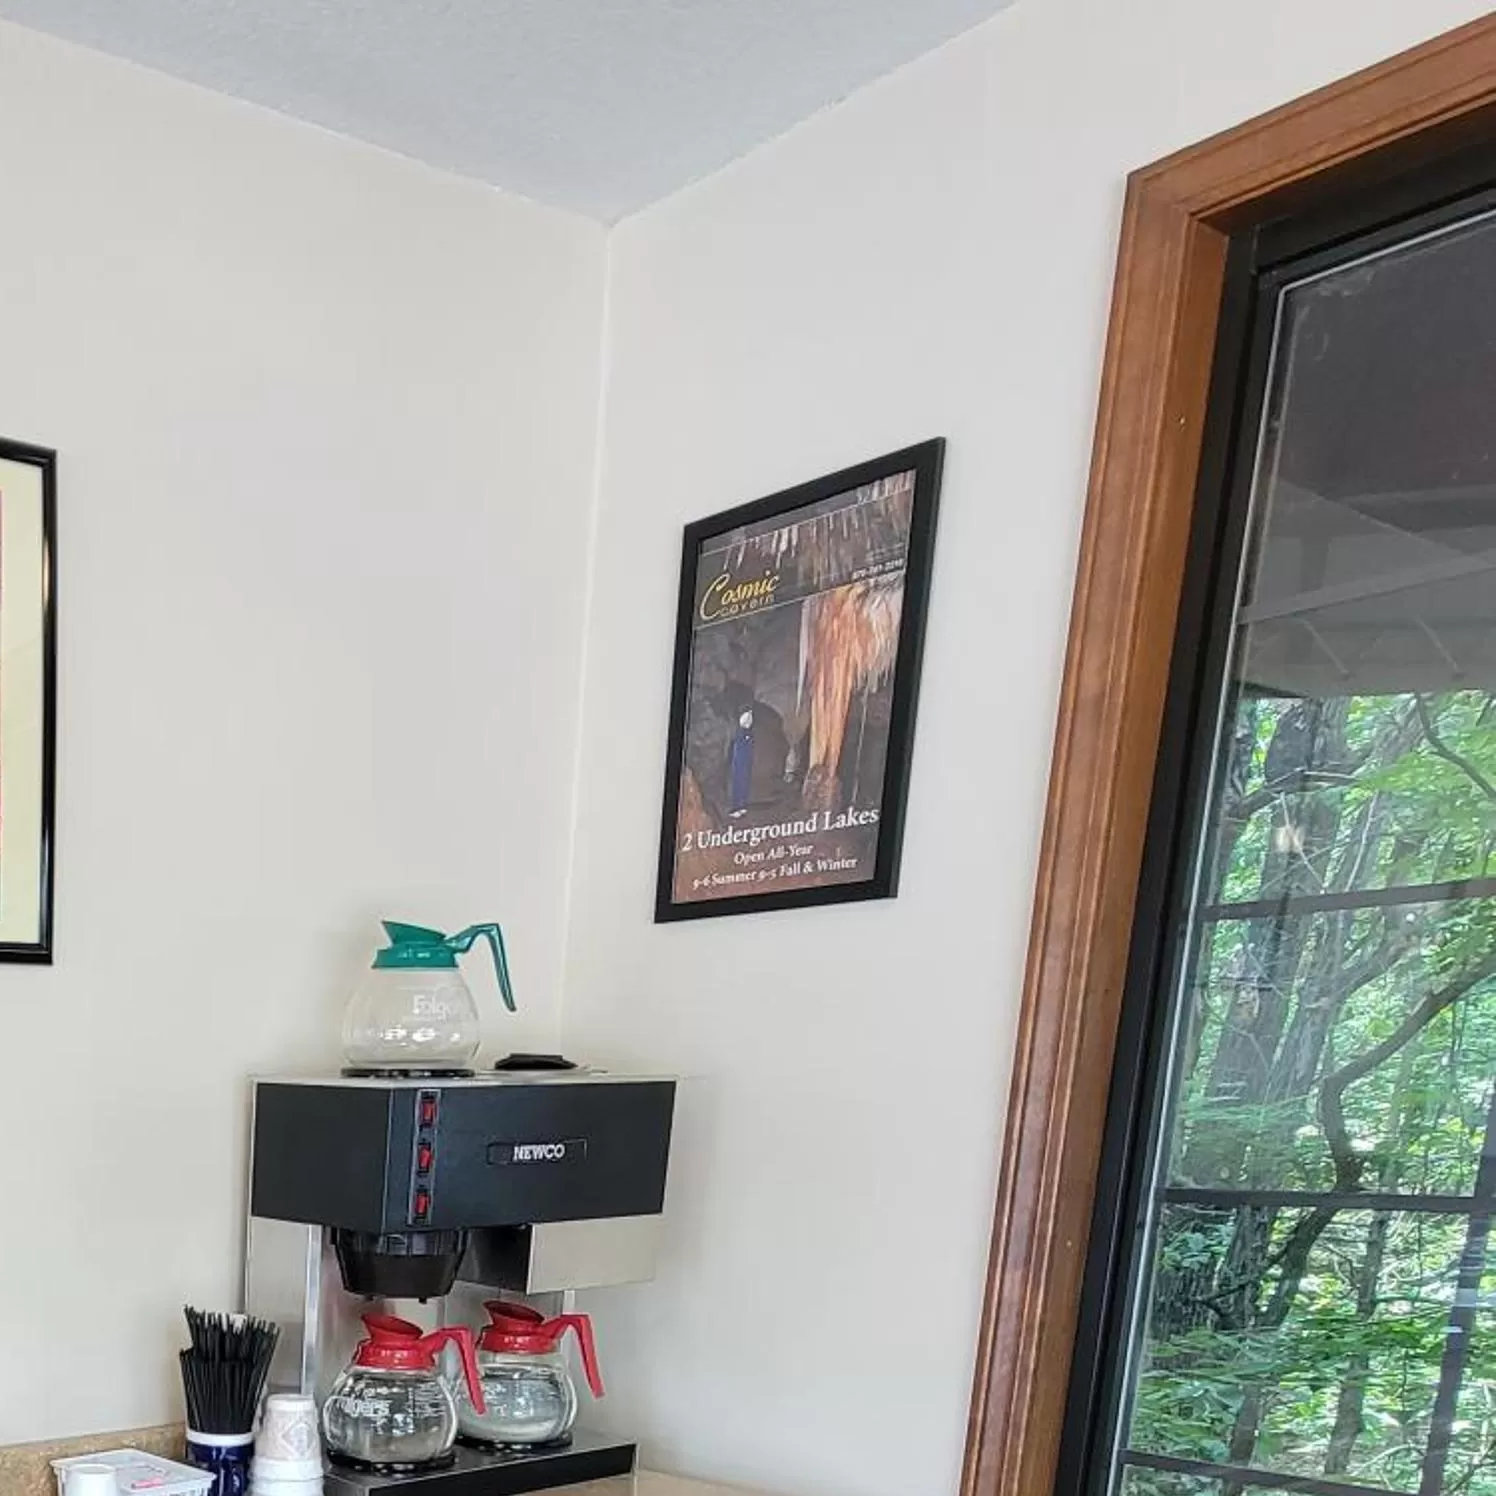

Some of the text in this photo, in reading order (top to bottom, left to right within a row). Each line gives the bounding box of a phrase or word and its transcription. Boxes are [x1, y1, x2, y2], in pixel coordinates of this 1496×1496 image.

[699, 570, 780, 620] Cosmic
[681, 806, 881, 852] 2 Underground Lakes
[734, 843, 814, 867] Open All-Year
[712, 870, 758, 887] Summer
[779, 860, 801, 877] Fall
[803, 860, 814, 873] &
[817, 856, 858, 873] Winter
[512, 1143, 566, 1162] NEWCO
